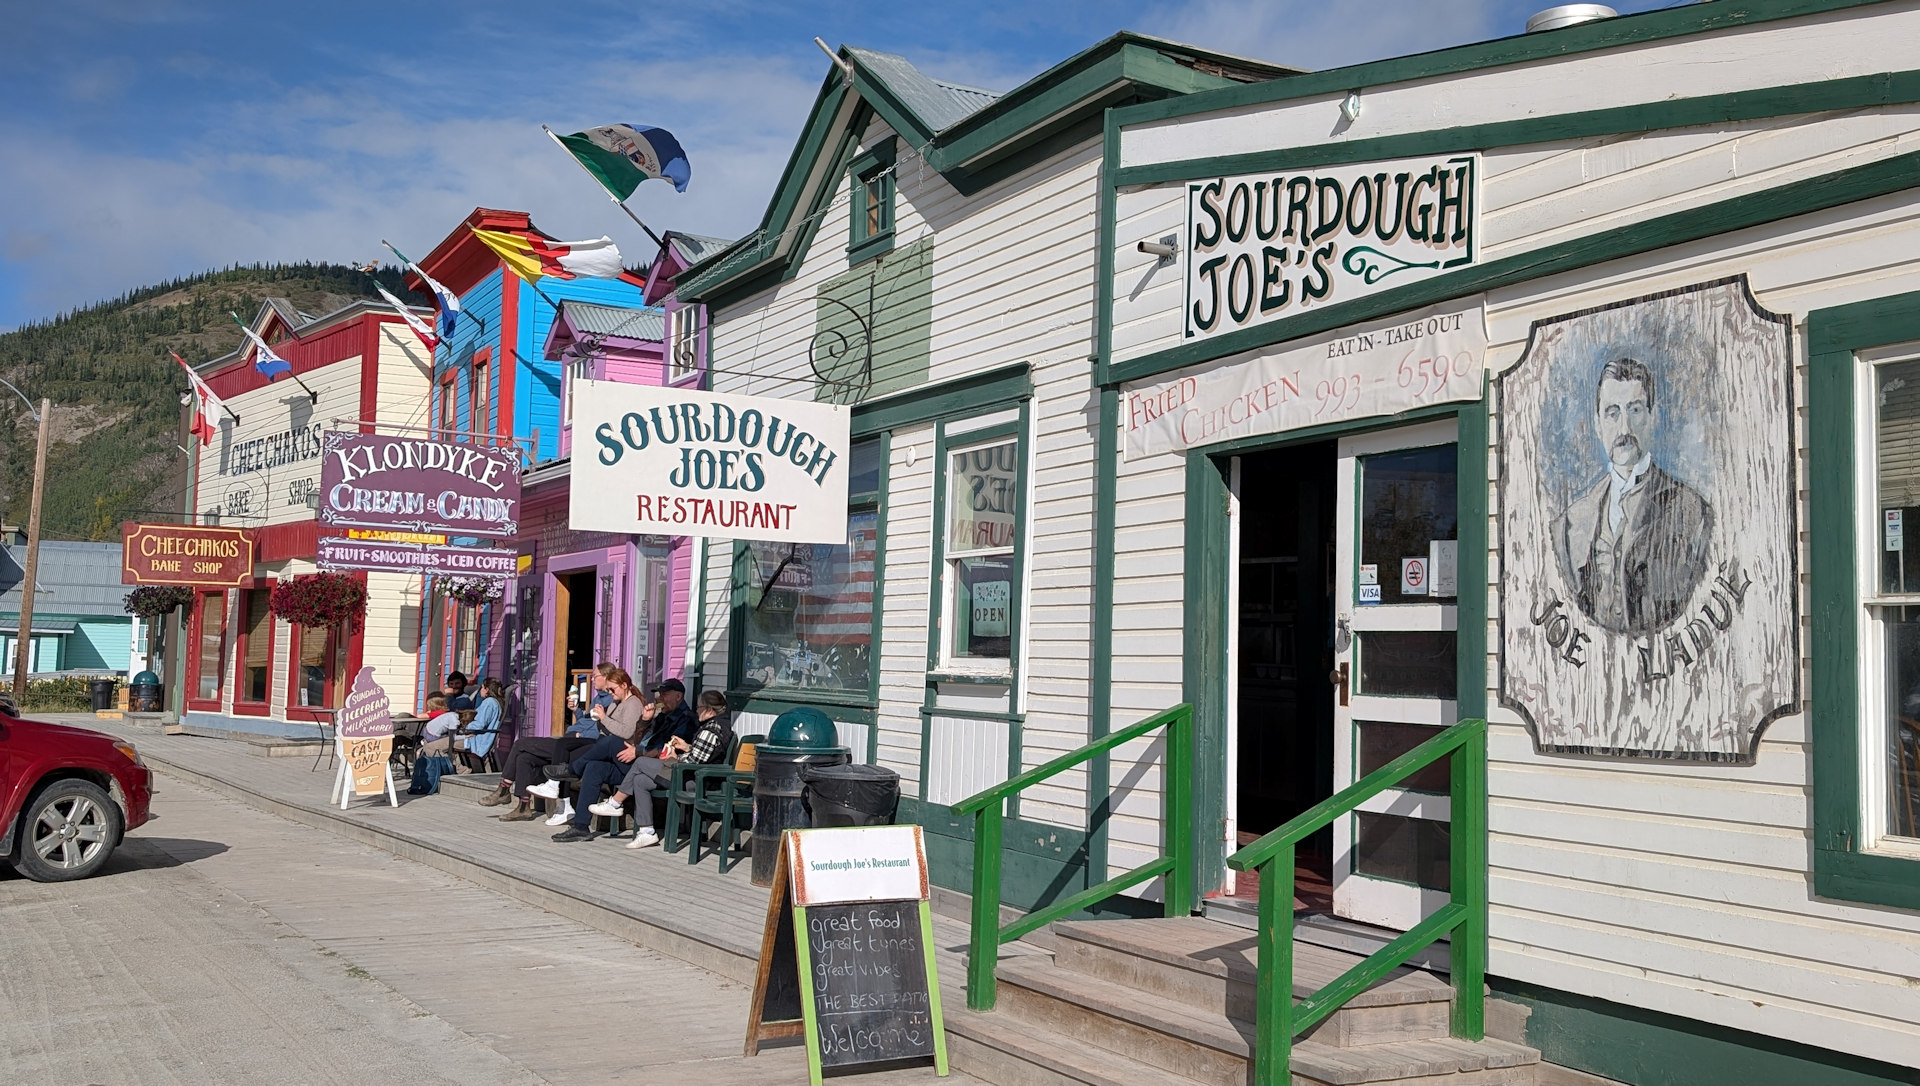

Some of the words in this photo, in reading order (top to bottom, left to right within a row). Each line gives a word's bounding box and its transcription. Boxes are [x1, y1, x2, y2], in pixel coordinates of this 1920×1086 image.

[1193, 164, 1470, 251] SOURDOUGH
[1193, 242, 1335, 332] JOE'S
[1326, 338, 1354, 360] EAT
[1355, 336, 1374, 353] IN
[1385, 322, 1424, 347] TAKE
[1427, 313, 1464, 335] OUT
[1129, 377, 1197, 433] FRIED
[1180, 370, 1300, 446] CHICKEN
[1315, 373, 1362, 417] 993
[1397, 349, 1474, 399] 6590
[231, 423, 322, 476] CHEECHAKOS
[595, 402, 838, 488] SOURDOUGH
[333, 441, 507, 492] KLONDYKE
[669, 447, 766, 493] JOE'S
[228, 489, 250, 516] BAKE
[288, 477, 314, 505] SHOP
[330, 483, 425, 515] CREAM
[437, 490, 516, 523] CANDY
[637, 494, 798, 531] RESTAURANT
[140, 534, 239, 558] CHEECHAKOS
[475, 557, 516, 571] COFFEE
[151, 559, 182, 572] BAKE
[193, 562, 223, 574] SHOP
[1361, 588, 1380, 598] VISA
[974, 607, 1005, 622] OPEN
[1530, 587, 1592, 669] JOE
[1637, 559, 1753, 685] LADUE
[352, 687, 381, 705] SUNDAES
[351, 740, 382, 758] CASH
[354, 751, 381, 770] ONLY
[810, 858, 852, 872] Sourdough
[853, 858, 872, 869] Joe's
[872, 857, 911, 868] Restaurant
[811, 911, 862, 953] great
[868, 910, 900, 930] food
[868, 934, 915, 952] tunes
[816, 960, 854, 991] great
[815, 993, 842, 1010] THE
[850, 992, 888, 1008] BEST
